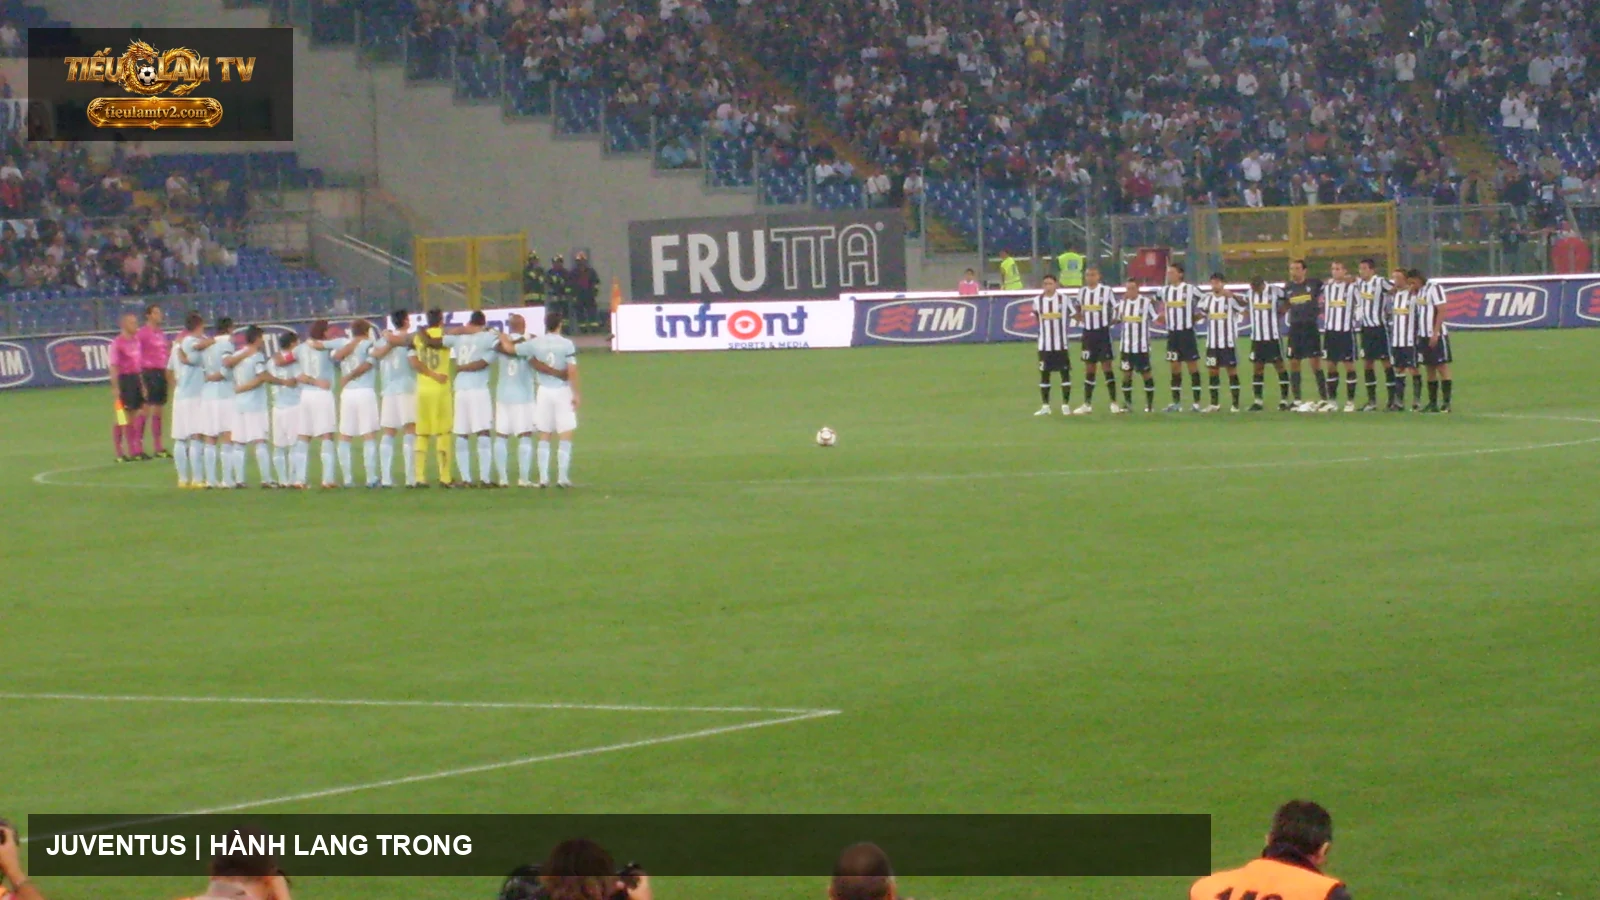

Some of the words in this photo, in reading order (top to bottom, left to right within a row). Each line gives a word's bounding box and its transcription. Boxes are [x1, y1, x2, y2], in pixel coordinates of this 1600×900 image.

[651, 223, 880, 296] FRUTTA
[1484, 291, 1537, 317] TIM
[655, 301, 808, 340] infront
[917, 307, 966, 332] TIM
[728, 342, 766, 350] SPORTS
[778, 341, 809, 349] MEDIA
[0, 350, 25, 376] IM
